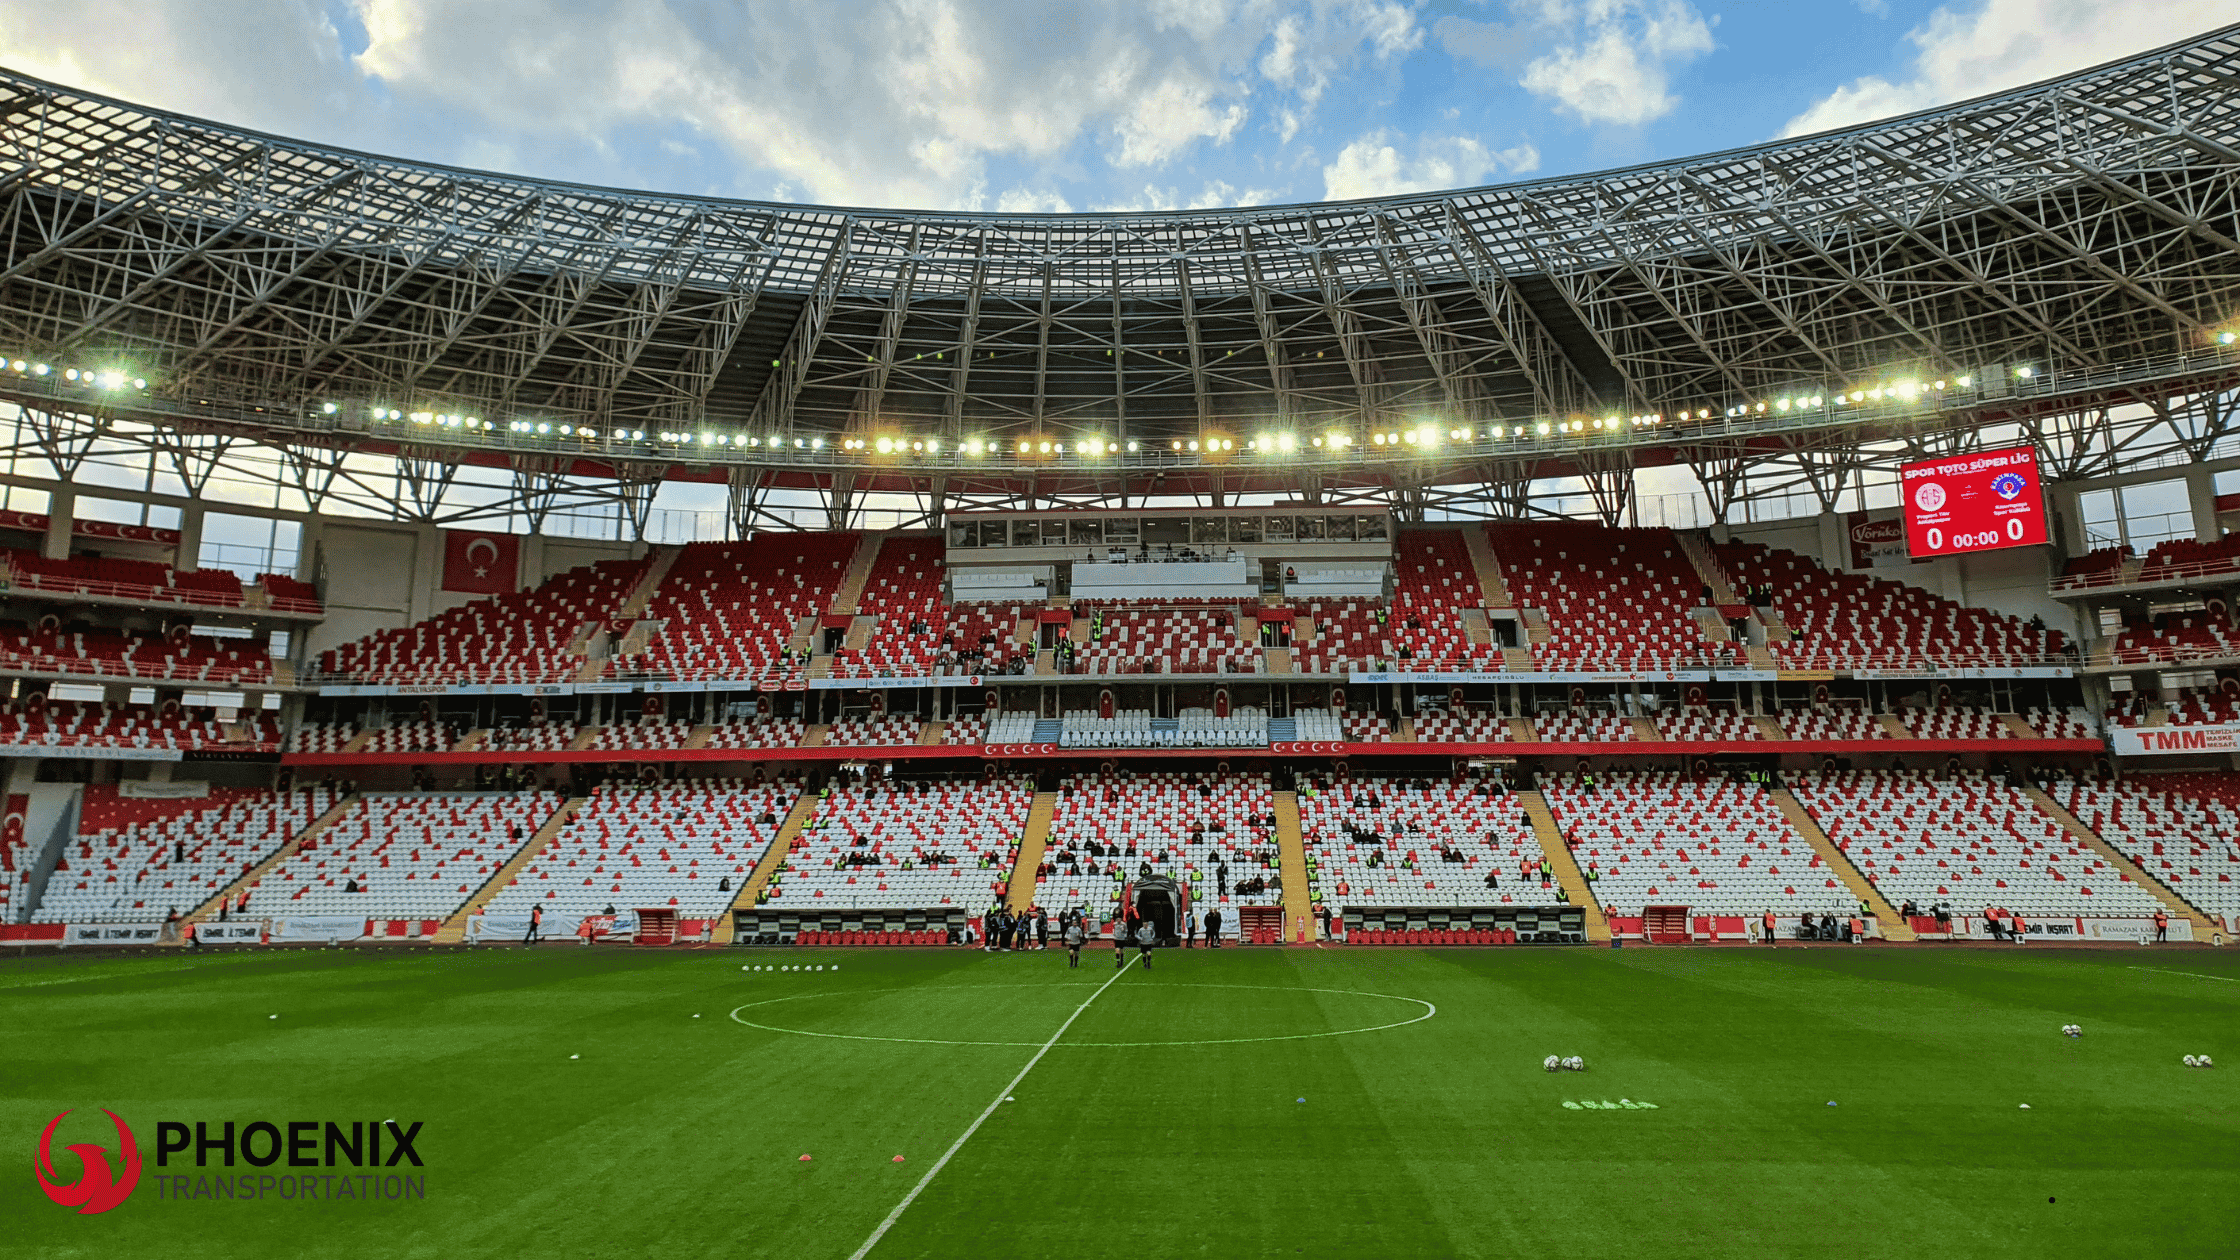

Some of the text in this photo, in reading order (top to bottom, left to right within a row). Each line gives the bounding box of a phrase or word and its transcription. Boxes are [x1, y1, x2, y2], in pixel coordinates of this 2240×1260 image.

[1904, 467, 1935, 480] SPOR
[1936, 462, 1968, 475] TOTO
[1969, 457, 2009, 470] SÜPER
[2010, 452, 2030, 465] LİG
[1856, 526, 1902, 541] Yörüko
[1926, 527, 1943, 550] 0
[1952, 530, 1999, 549] 00:00
[2006, 518, 2024, 541] 0
[397, 685, 447, 694] ANTALYASPOR
[2136, 730, 2207, 751] TMM
[2102, 925, 2138, 933] RAMAZAN
